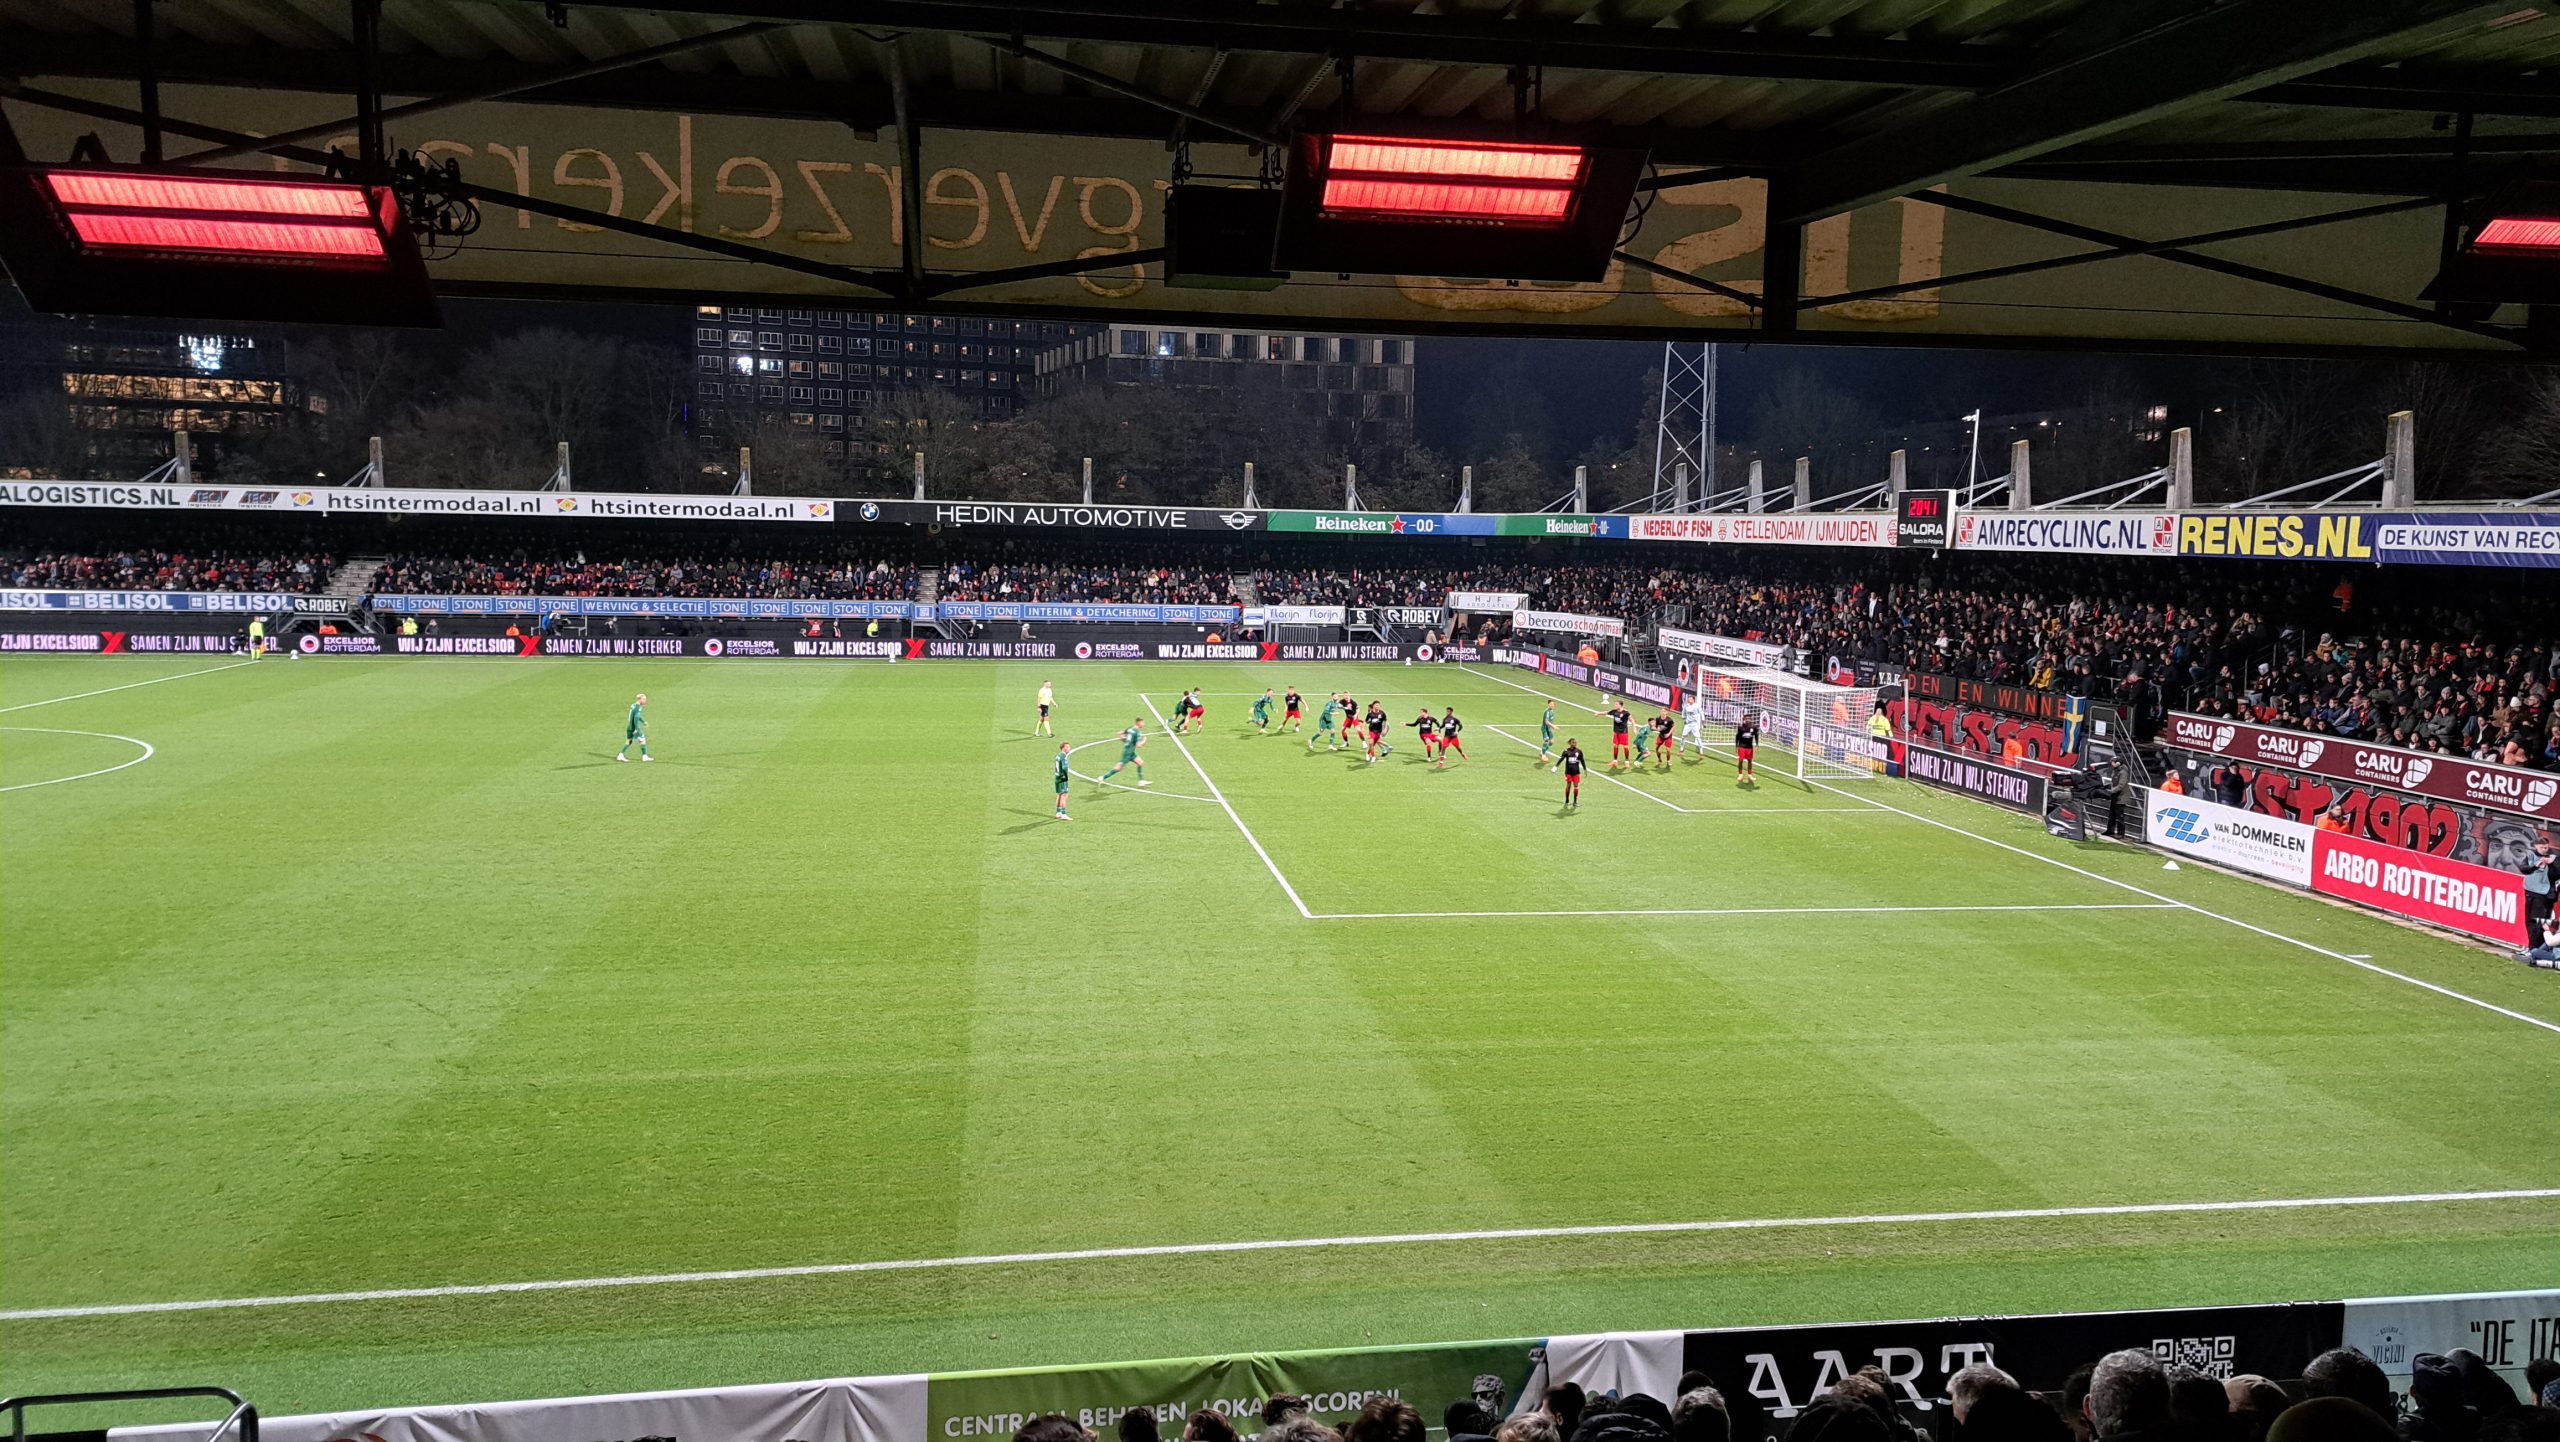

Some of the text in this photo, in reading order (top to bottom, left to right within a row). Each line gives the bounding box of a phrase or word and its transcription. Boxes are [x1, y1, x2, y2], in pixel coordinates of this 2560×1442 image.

[327, 493, 541, 514] htsintermodaal.nl
[591, 499, 794, 519] htsintermodaal.nl
[936, 506, 1187, 527] HEDIN AUTOMOTIVE
[1315, 516, 1386, 531] Heineken
[1546, 519, 1588, 534] Heineken
[1644, 520, 1713, 538] NEDERLOF FISH
[1733, 521, 1804, 539] STELLENDAM
[1816, 521, 1878, 542] IJMUIDEN
[1899, 523, 1944, 537] SALORA
[1977, 519, 2147, 550] AMRECYCLING.NL
[2180, 515, 2371, 558] RENES.NL
[2384, 530, 2407, 545] DE
[2411, 530, 2469, 546] KUNST
[2473, 531, 2513, 548] VAN
[0, 594, 53, 609] ISOL
[84, 594, 173, 610] BELISOL
[205, 595, 295, 610] BELISOL
[309, 599, 347, 612] ROBEY
[372, 600, 404, 610] TONE
[410, 599, 448, 609] STONE
[454, 600, 490, 610] STONE
[498, 600, 534, 610] STONE
[541, 601, 577, 611] STONE
[585, 602, 704, 612] WERVING & SELECTIE
[711, 602, 746, 612] STONE
[753, 603, 788, 613] STONE
[794, 603, 828, 613] STONE
[835, 603, 868, 614] STONE
[875, 604, 908, 614] STONE
[946, 606, 980, 615] STONE
[987, 607, 1019, 616] STONE
[1028, 608, 1156, 617] INTERIM & DETACHERING
[1164, 609, 1196, 618] STONE
[1202, 610, 1233, 619] STONE
[1270, 609, 1300, 620] florijn
[1309, 609, 1339, 620] florijn
[1401, 610, 1439, 624] ROBEY
[0, 634, 31, 650] ZIJN
[33, 635, 99, 650] EXCELSIOR
[131, 636, 170, 651] SAMEN
[174, 636, 200, 651] ZIJN
[203, 637, 226, 651] WIJ
[324, 637, 375, 645] EXCELSIOR
[324, 644, 381, 652] ROTTERDAM
[398, 637, 423, 652] WIJ
[425, 638, 453, 652] ZIJN
[455, 638, 515, 653] EXCELSIOR
[546, 639, 581, 654] SAMEN
[586, 639, 611, 654] ZIJN
[614, 639, 634, 654] WIJ
[638, 639, 682, 654] STERKER
[727, 640, 774, 648] EXCELSIOR
[794, 641, 816, 655] WIJ
[819, 641, 844, 656] ZIJN
[846, 641, 902, 656] EXCELSIOR
[930, 642, 964, 657] SAMEN
[967, 643, 990, 657] ZIJN
[993, 643, 1012, 657] WIJ
[1015, 643, 1056, 658] STERKER
[1158, 644, 1179, 658] WIJ
[1182, 644, 1205, 659] ZIJN
[1206, 644, 1258, 659] EXCELSIOR
[1283, 645, 1315, 660] SAMEN
[1316, 645, 1338, 660] ZIJN
[1340, 645, 1358, 660] WIJ
[1360, 645, 1399, 660] STERKER
[1443, 646, 1477, 654] CELSIOR
[1958, 681, 1984, 706] EN
[2176, 720, 2213, 742] CARU
[1846, 734, 1888, 760] EXCELSIOR
[2176, 736, 2211, 748] CONTAINERS
[2258, 734, 2299, 755] CARU
[2258, 750, 2297, 764] CONTAINERS
[2355, 750, 2403, 774] CARU
[1909, 750, 1940, 780] SAMEN
[1942, 756, 1963, 787] ZIJN
[1965, 764, 1984, 792] WIJ
[1986, 771, 2029, 805] STERKER
[2355, 769, 2400, 784] CONTAINERS
[2466, 770, 2522, 796] CARU
[2466, 790, 2519, 806] CONTAINERS
[2340, 787, 2461, 859] 1902
[2214, 823, 2230, 834] VAN
[2231, 823, 2306, 853] DOMMELEN
[2324, 848, 2518, 925] ARBO ROTTERDAM
[945, 1410, 1066, 1438] CENTR
[1079, 1402, 1186, 1429] BEHEN
